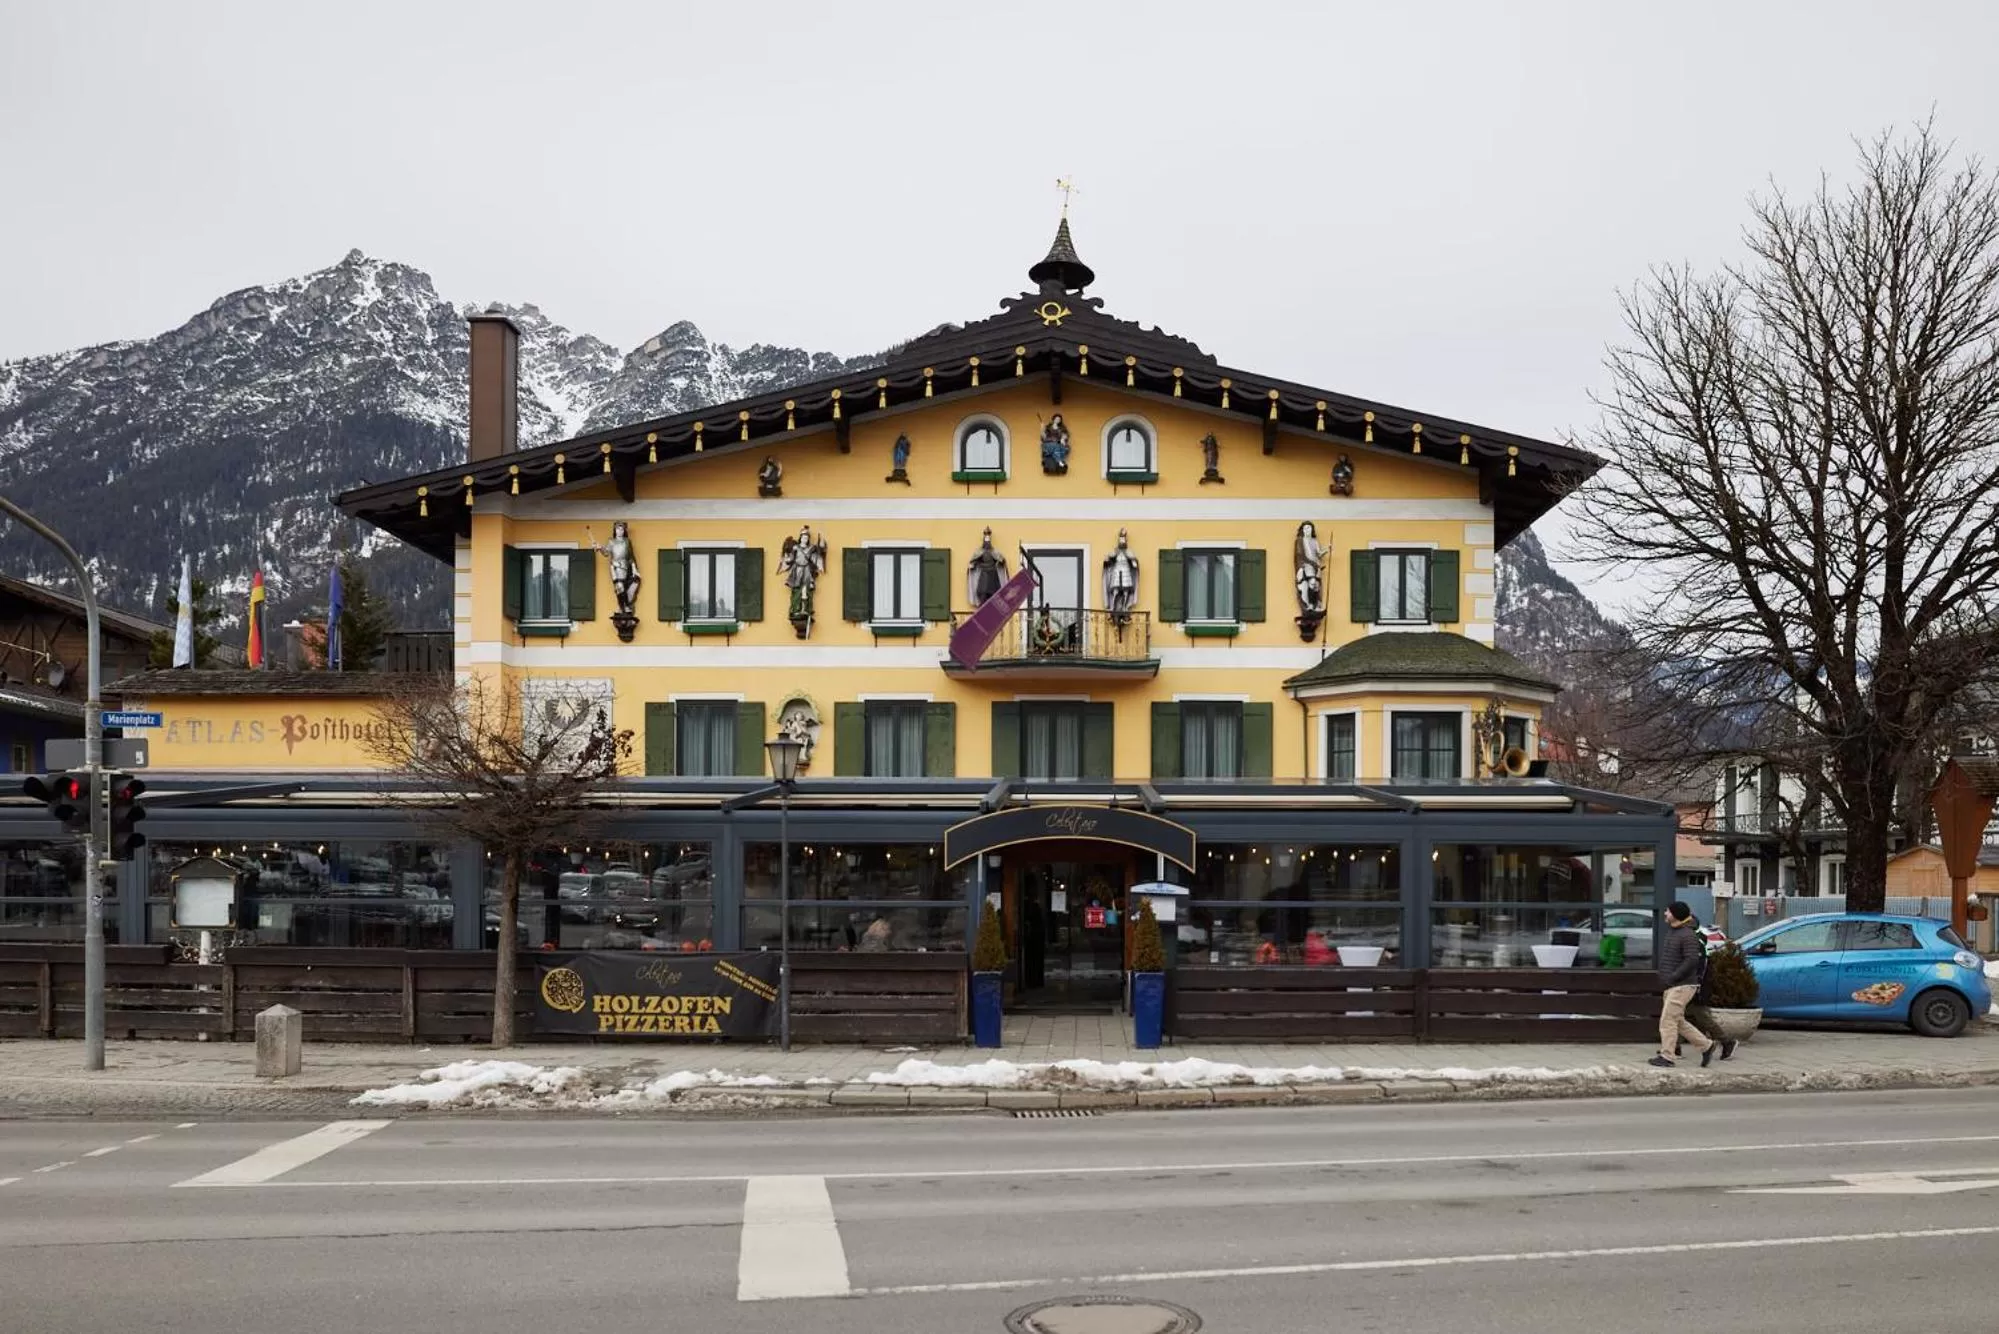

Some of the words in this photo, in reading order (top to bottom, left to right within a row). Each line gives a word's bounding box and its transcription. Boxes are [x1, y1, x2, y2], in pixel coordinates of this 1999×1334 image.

[108, 713, 155, 727] Marienplatz
[592, 995, 732, 1014] HOLZOFEN
[598, 1014, 722, 1033] PIZZERIA
